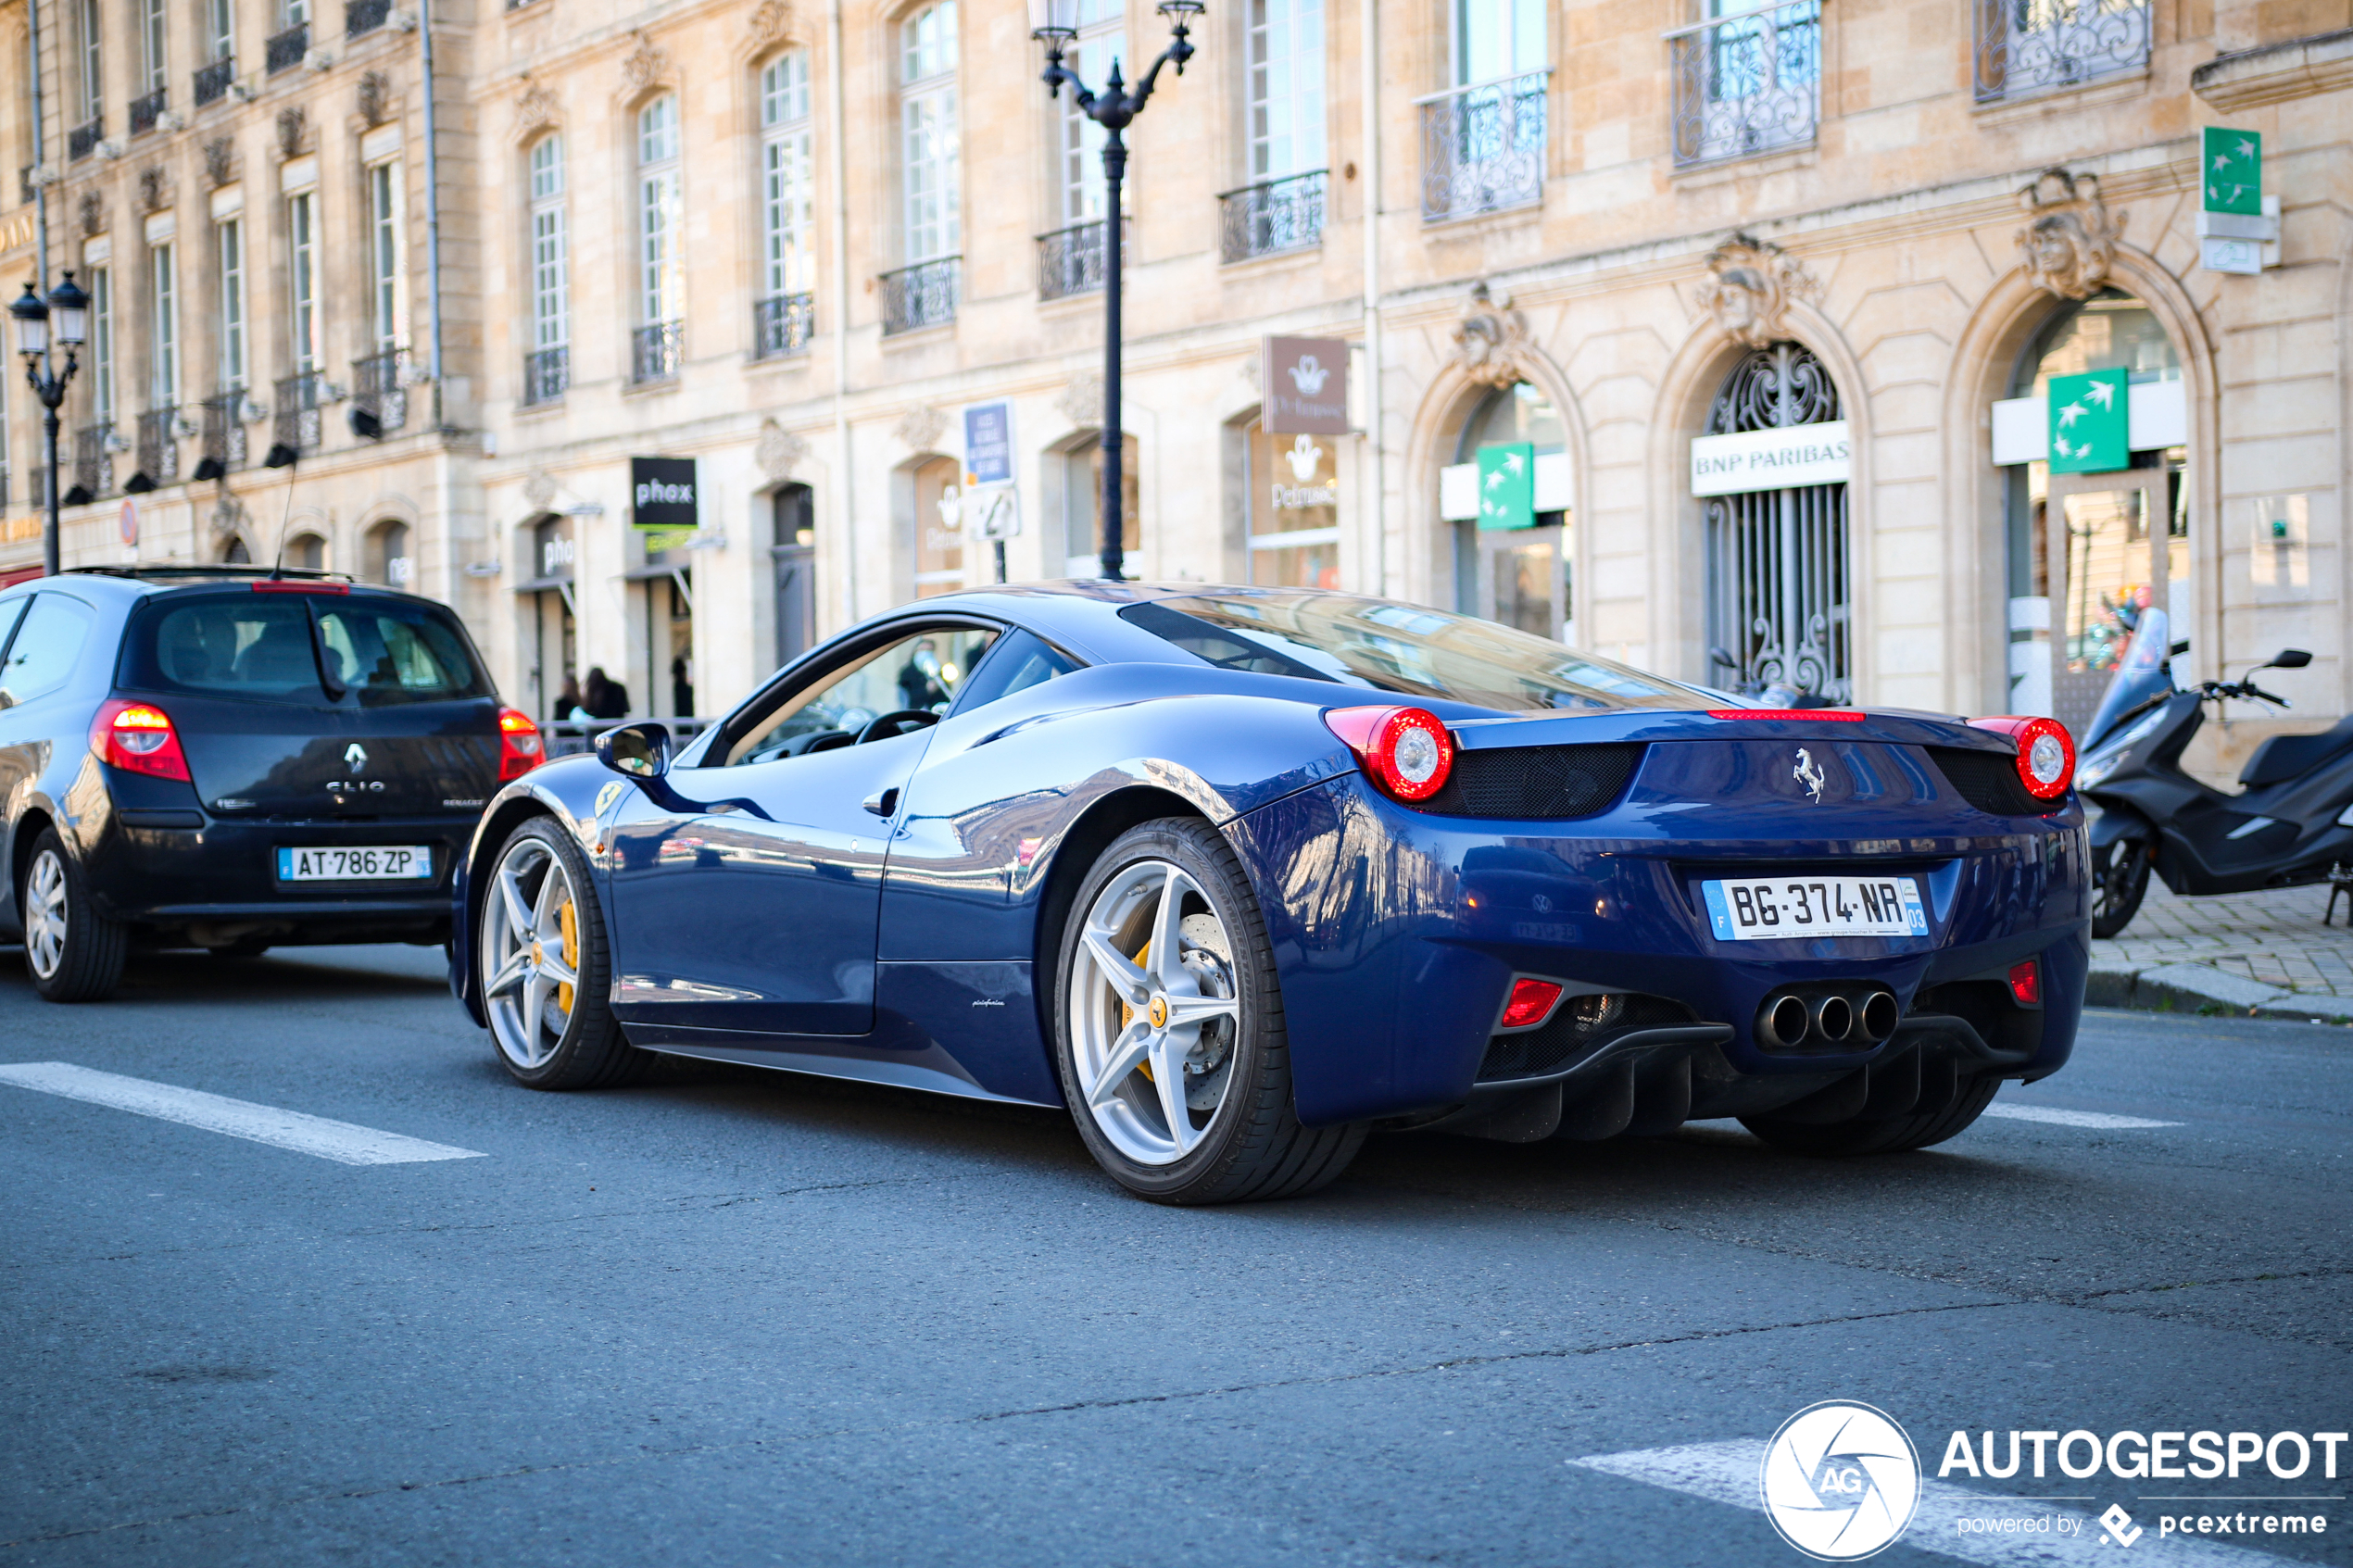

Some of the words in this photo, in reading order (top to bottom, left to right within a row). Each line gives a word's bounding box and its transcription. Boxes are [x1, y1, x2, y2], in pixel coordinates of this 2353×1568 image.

[1695, 453, 1743, 475] BNP
[1749, 441, 1849, 470] PARIBAS
[635, 477, 694, 508] phox
[326, 781, 385, 793] CLIO
[443, 797, 484, 807] RENAULT
[1717, 915, 1725, 928] F
[1731, 883, 1903, 927] BG-374-NR
[1908, 909, 1926, 929] 03
